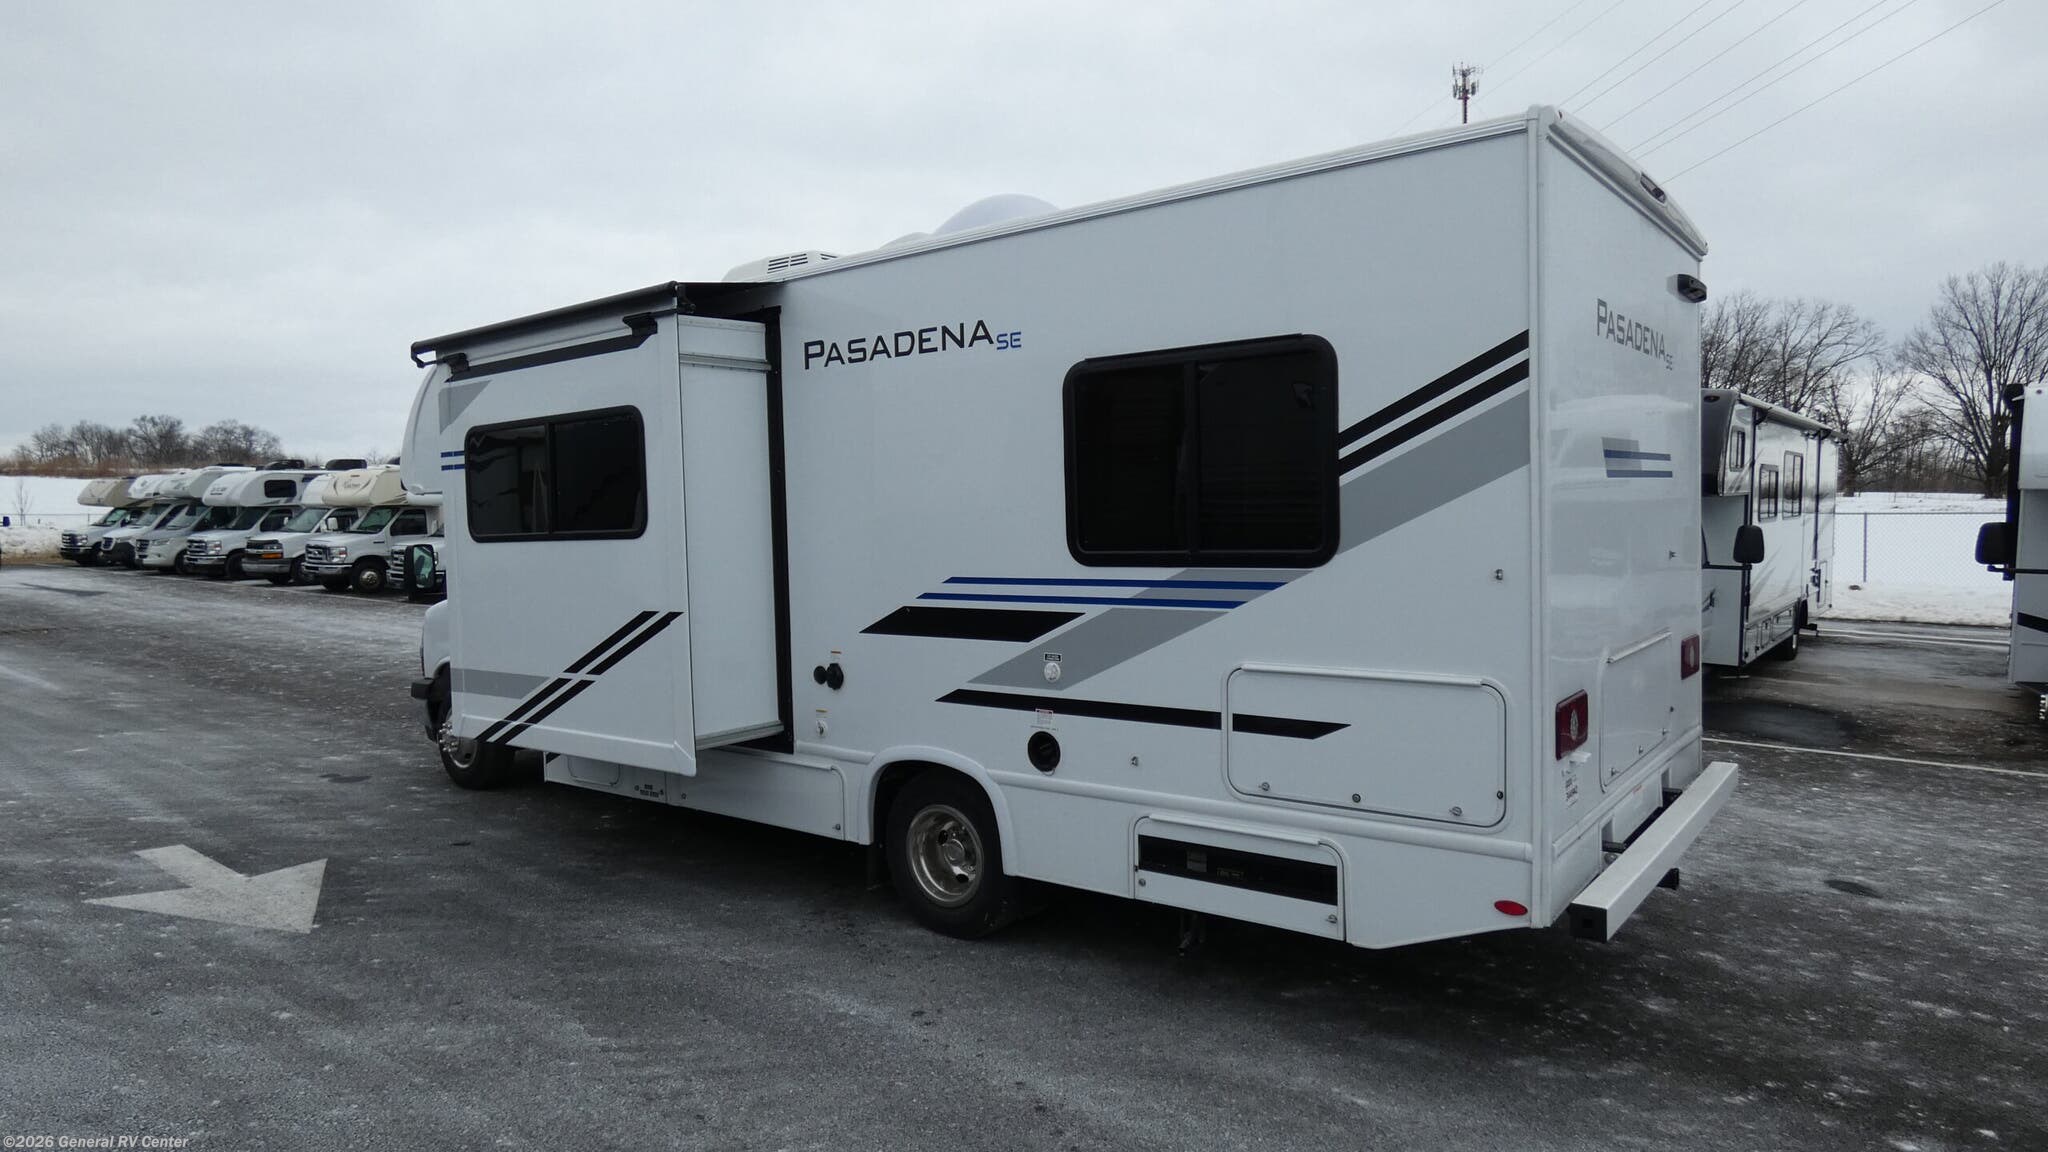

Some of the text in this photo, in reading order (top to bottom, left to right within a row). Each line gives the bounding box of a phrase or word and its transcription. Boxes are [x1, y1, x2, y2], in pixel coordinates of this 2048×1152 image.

[804, 319, 1022, 370] PASADENA SE
[1597, 298, 1665, 361] PASADENA
